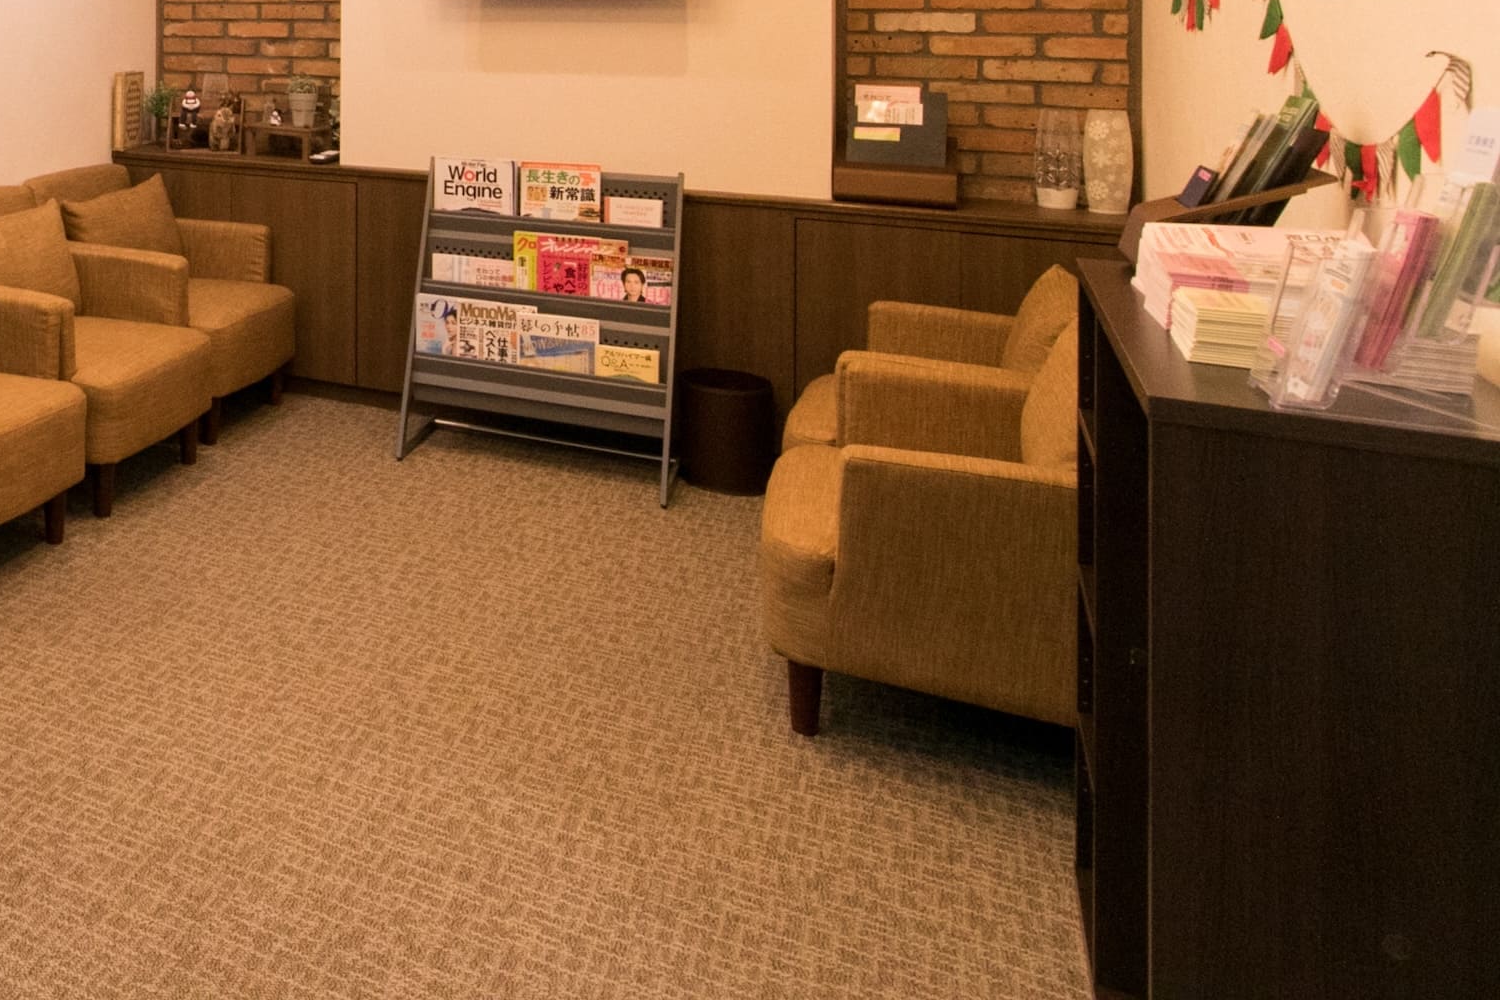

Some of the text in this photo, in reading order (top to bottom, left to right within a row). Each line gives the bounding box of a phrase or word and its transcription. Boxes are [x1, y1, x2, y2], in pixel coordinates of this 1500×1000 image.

[448, 165, 497, 183] World
[526, 169, 581, 186] 長生きの
[443, 180, 503, 200] Engine
[550, 185, 596, 202] 新常識
[520, 319, 596, 338] 暮しの手帖 85
[601, 355, 629, 370] Q&A
